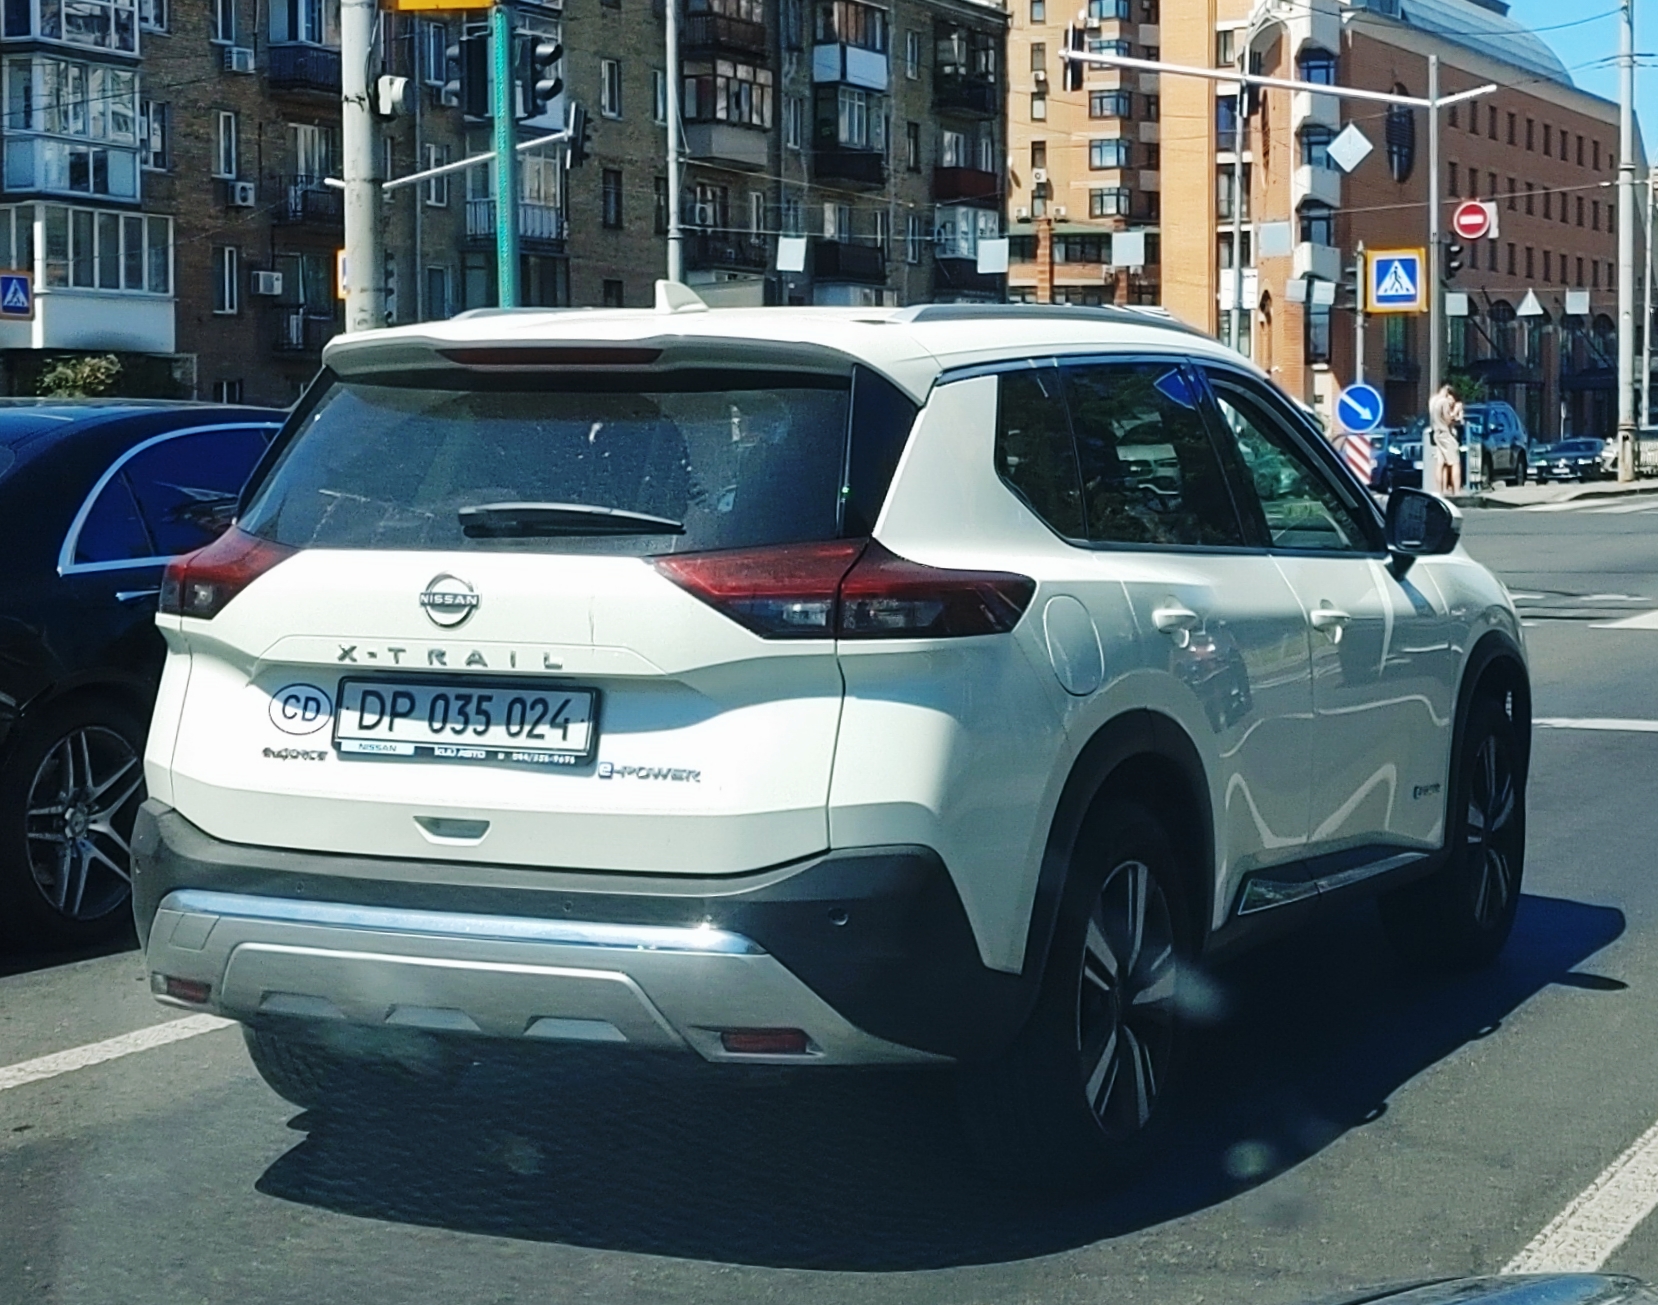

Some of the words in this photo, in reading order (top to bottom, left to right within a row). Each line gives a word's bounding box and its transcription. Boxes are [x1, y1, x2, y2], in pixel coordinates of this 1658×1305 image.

[420, 593, 478, 606] NISSAN
[337, 644, 563, 670] X-TRAIL
[281, 694, 321, 722] CD
[358, 689, 416, 733] DP
[428, 693, 494, 736] 035
[505, 697, 572, 742] 024
[358, 743, 397, 752] NISSAN
